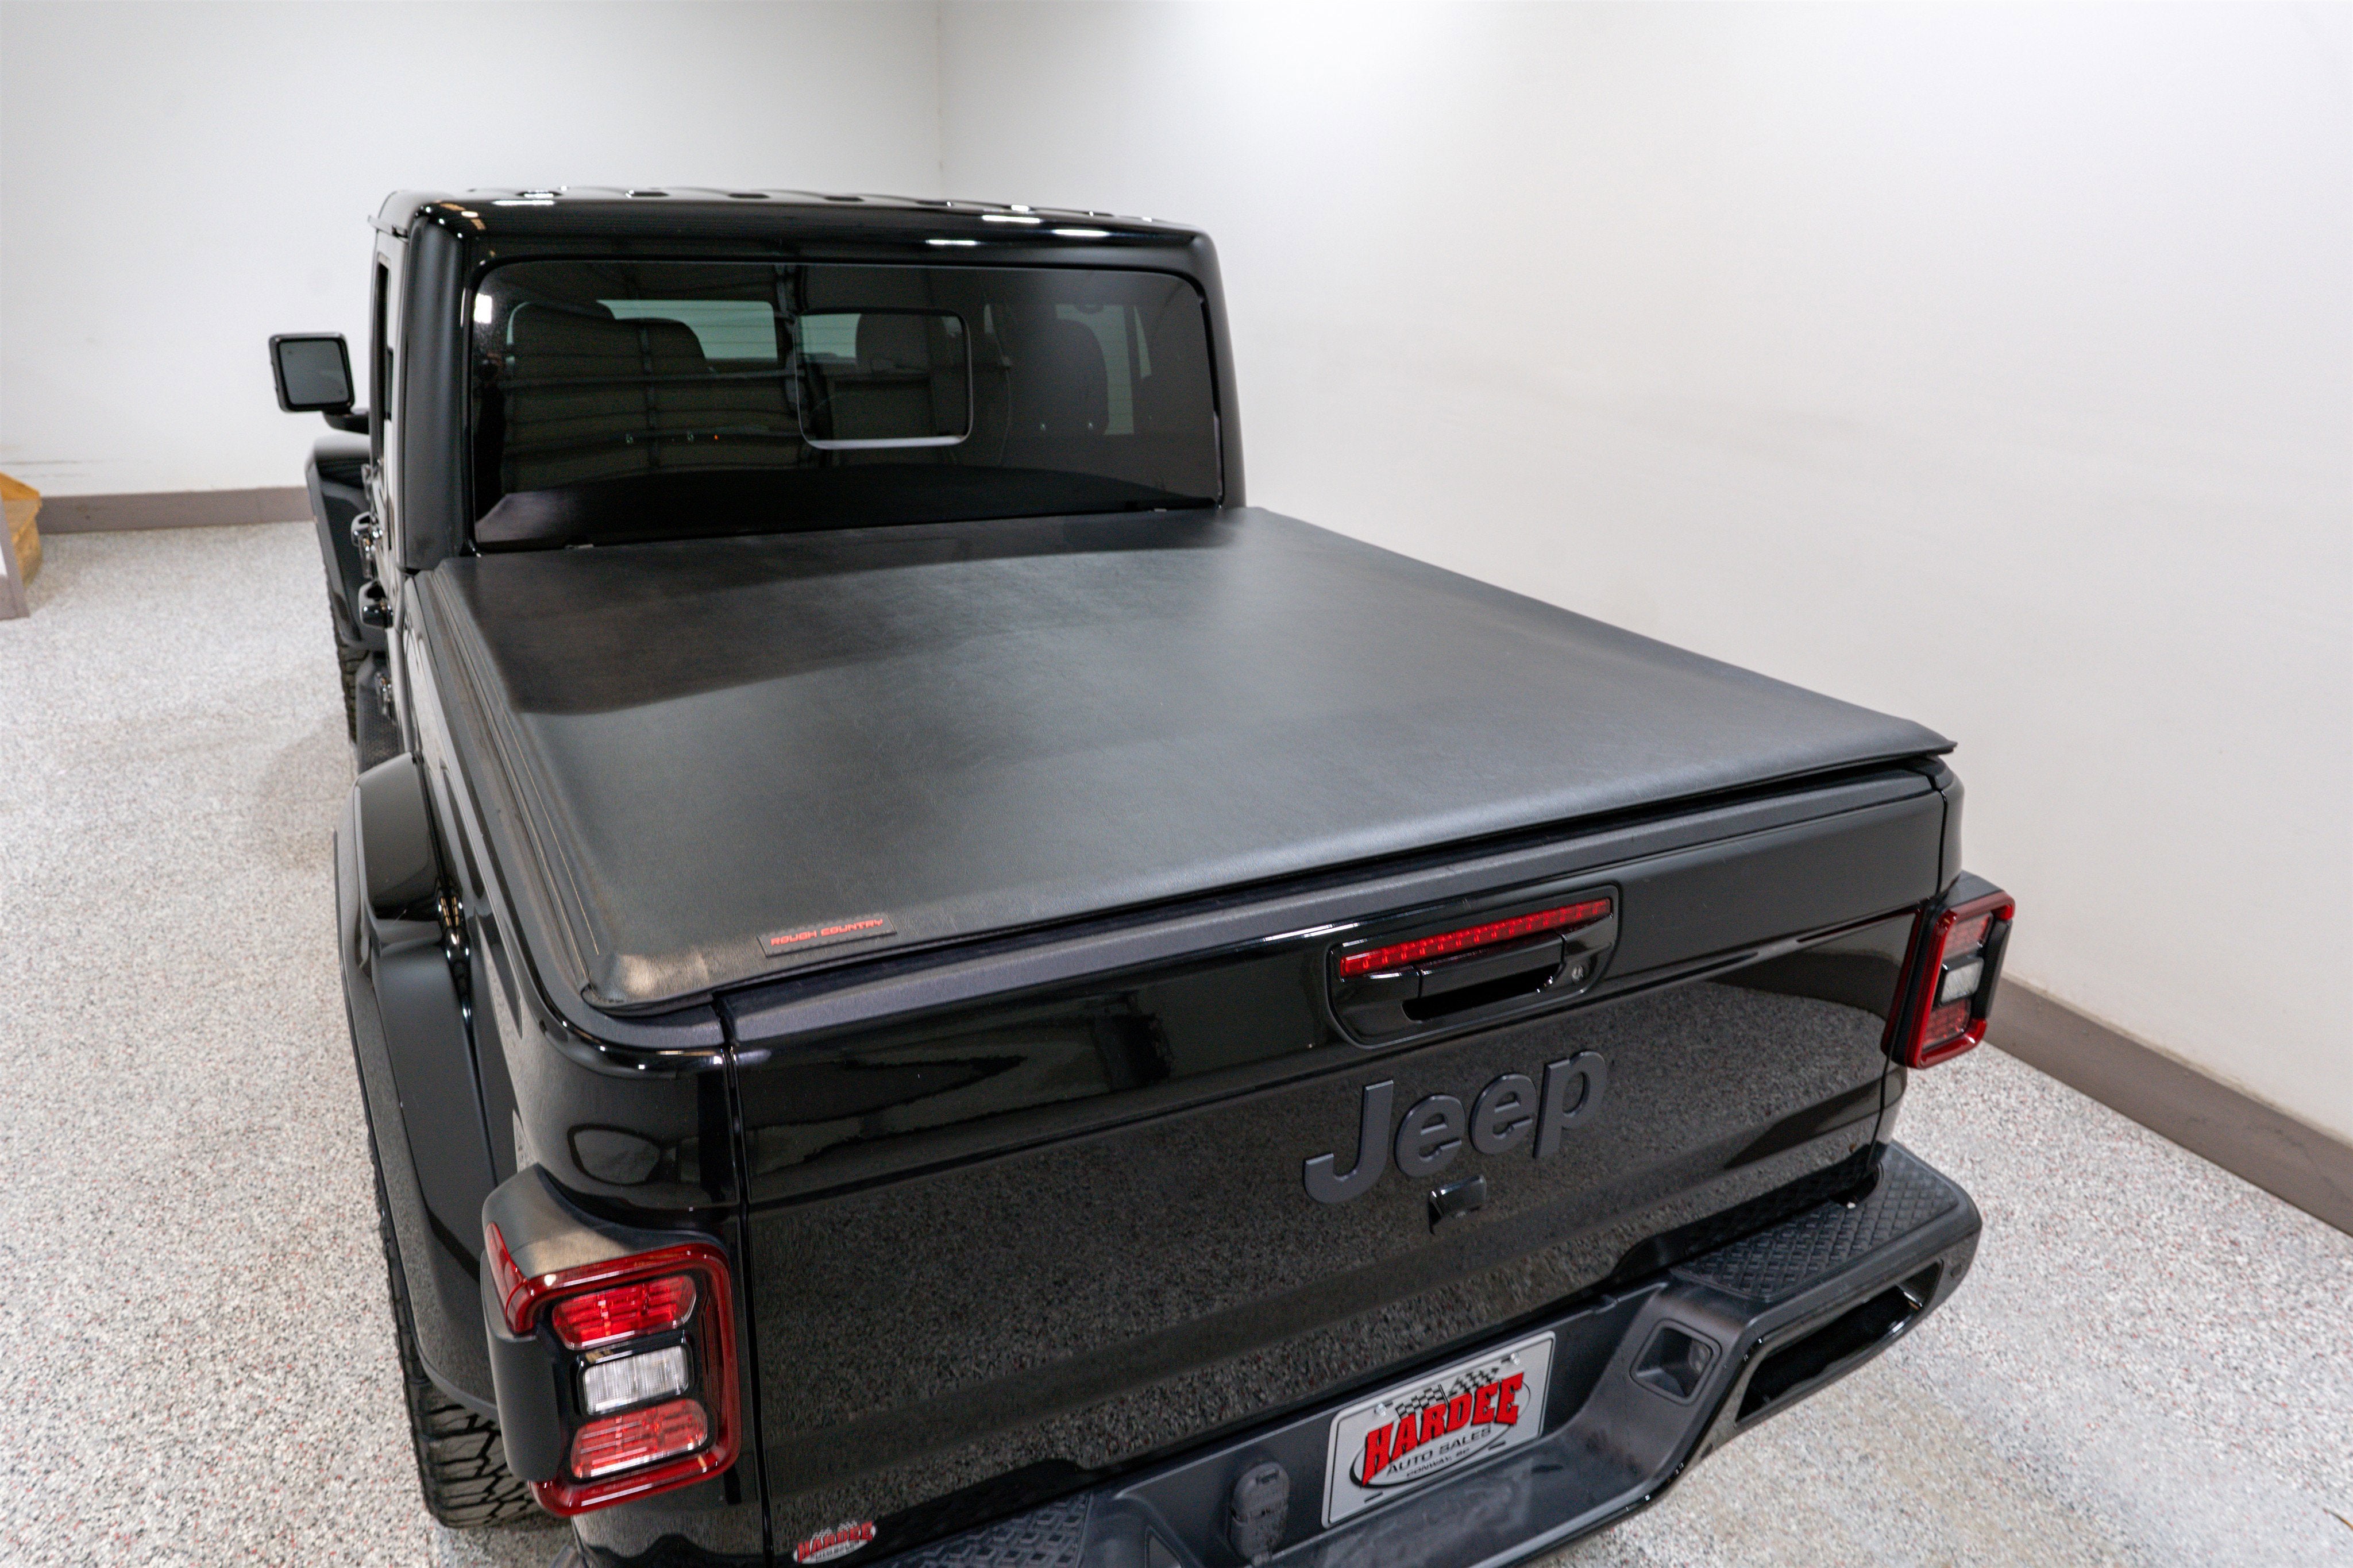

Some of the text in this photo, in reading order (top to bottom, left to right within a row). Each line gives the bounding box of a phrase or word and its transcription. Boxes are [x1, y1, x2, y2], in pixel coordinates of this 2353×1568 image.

[770, 919, 883, 946] ROUGH COUNTRY
[1302, 1049, 1607, 1204] Jeep
[1361, 1372, 1525, 1486] HARDEE
[1387, 1424, 1491, 1477] AUTO SALES
[797, 1520, 873, 1563] HARDEE
